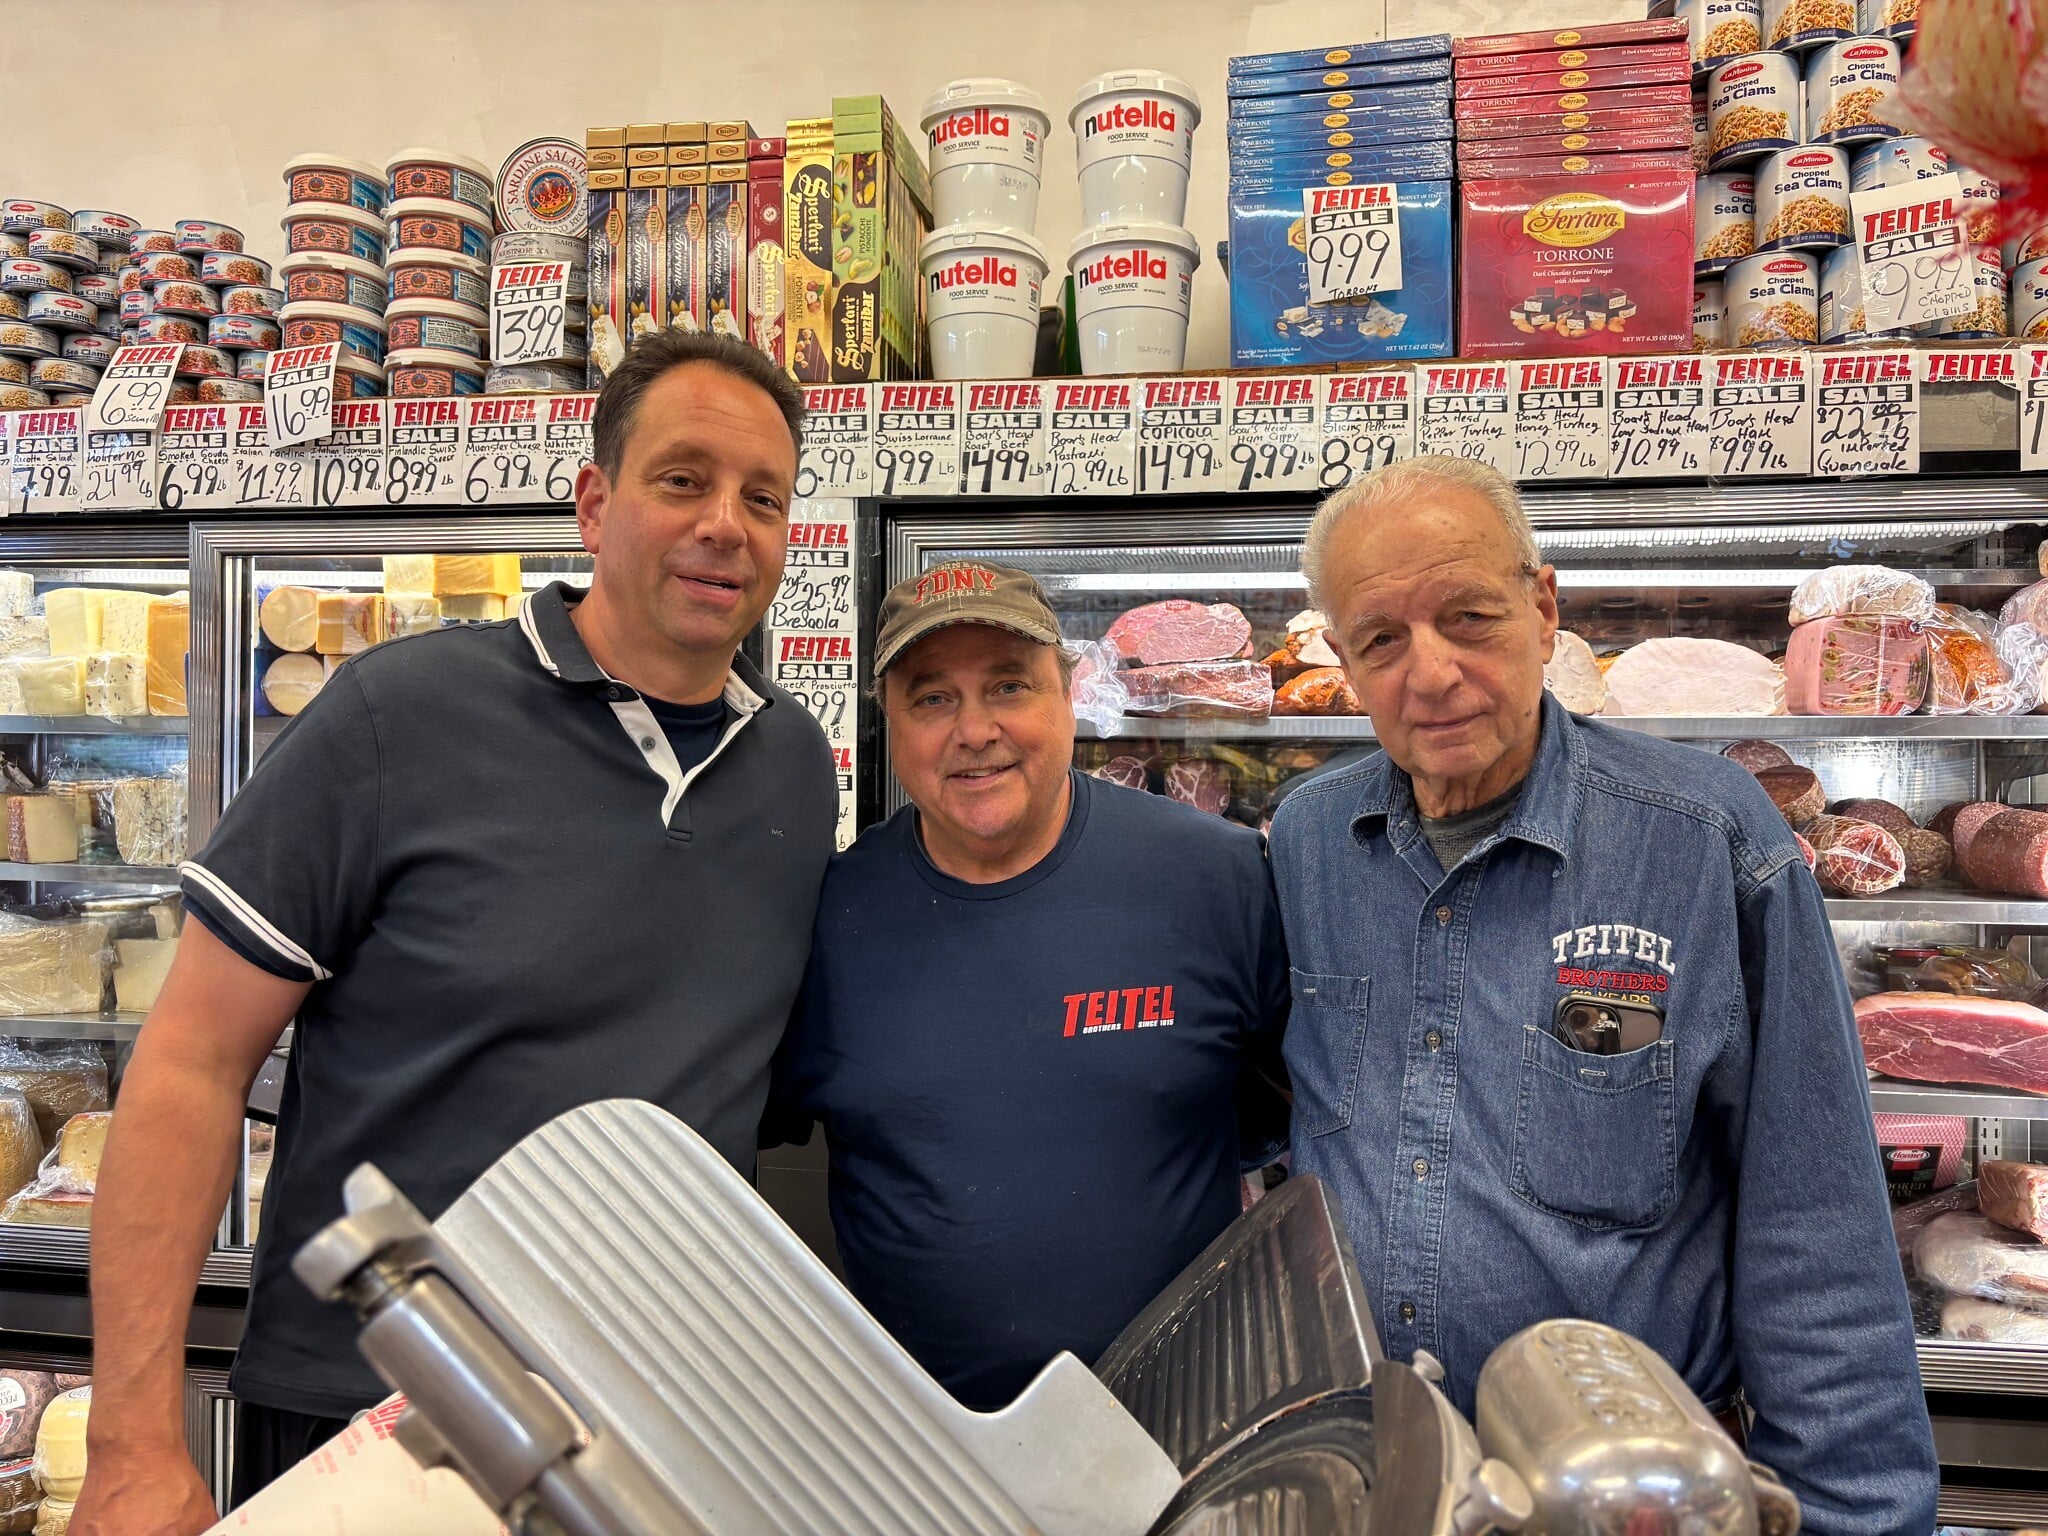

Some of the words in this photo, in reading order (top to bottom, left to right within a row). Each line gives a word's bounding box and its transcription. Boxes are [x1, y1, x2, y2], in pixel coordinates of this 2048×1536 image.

[1707, 4, 1731, 15] Sea
[1476, 56, 1518, 66] TORRONE
[1848, 63, 1885, 71] Chopped
[1476, 77, 1519, 87] TORRONE
[1723, 78, 1759, 93] Chopped
[1830, 74, 1851, 87] Sea
[1860, 70, 1897, 83] Clams
[1476, 98, 1518, 107] TORRONE
[1712, 97, 1729, 111] Sea
[1733, 86, 1776, 100] Clams
[1085, 100, 1176, 139] nutella
[930, 108, 1009, 151] nutella
[1107, 133, 1123, 141] FOOD
[944, 144, 956, 152] FOOD
[508, 151, 541, 205] SARDINE
[545, 149, 588, 177] SALATE
[1792, 169, 1830, 179] Chopped
[1775, 182, 1800, 195] Sea
[1803, 177, 1842, 190] Clams
[1962, 188, 1988, 199] Sea
[1312, 187, 1391, 215] TEITEL
[1714, 205, 1739, 214] Sea
[15, 215, 44, 224] Clams
[799, 173, 830, 255] Sperlari
[1315, 210, 1388, 232] SALE
[1527, 208, 1618, 233] Ferrara
[1863, 198, 1956, 243] TEITEL
[1876, 229, 1907, 240] BROTHERS
[1921, 223, 1938, 231] SINCE
[1869, 229, 1954, 261] SALE
[594, 236, 606, 290] Torrone
[635, 236, 647, 289] Torrone
[675, 233, 688, 287] Torrone
[715, 231, 728, 284] Torrone
[1533, 248, 1614, 262] TORRONE
[497, 264, 563, 290] TEITEL
[930, 257, 1017, 294] nutella
[1079, 250, 1167, 289] nutella
[1533, 269, 1547, 277] Dark
[1594, 268, 1613, 276] Nougat
[20, 274, 50, 284] Clams
[1767, 277, 1804, 285] Chopped
[498, 287, 558, 305] SALE
[1098, 284, 1113, 293] FOOD
[1750, 288, 1776, 299] Sea
[1779, 284, 1814, 297] Clams
[44, 308, 60, 316] Sea
[64, 310, 91, 322] Clams
[835, 296, 864, 372] Sperlari
[81, 349, 110, 359] Clams
[115, 346, 179, 365] TEITEL
[271, 345, 333, 373] TEITEL
[110, 366, 168, 377] SALE
[1521, 362, 1601, 391] TEITEL
[1617, 360, 1702, 389] TEITEL
[1717, 357, 1804, 386] TEITEL
[1822, 355, 1911, 385] TEITEL
[1928, 354, 2014, 383] TEITEL
[271, 367, 327, 389] SALE
[1427, 367, 1507, 395] TEITEL
[969, 385, 1042, 411] TEITEL
[1055, 385, 1130, 411] TEITEL
[1145, 381, 1221, 408] TEITEL
[1236, 379, 1313, 406] TEITEL
[1328, 376, 1408, 403] TEITEL
[1719, 386, 1799, 405] SALE
[1825, 387, 1906, 405] SALE
[881, 386, 954, 411] TEITEL
[1428, 397, 1503, 412] SALE
[1521, 392, 1598, 409] SALE
[1619, 391, 1698, 407] SALE
[164, 407, 227, 432] TEITEL
[394, 401, 458, 427] TEITEL
[470, 400, 536, 425] TEITEL
[971, 414, 1039, 428] SALE
[1056, 414, 1126, 428] SALE
[1147, 410, 1217, 425] SALE
[1237, 409, 1309, 423] SALE
[1330, 405, 1404, 420] SALE
[1453, 412, 1480, 423] Head
[1554, 408, 1578, 419] Head
[1660, 407, 1695, 423] Head
[1765, 406, 1800, 425] Head
[18, 412, 77, 437] TEITEL
[883, 414, 951, 429] SALE
[1264, 423, 1287, 432] Head
[1515, 423, 1550, 435] Honey
[1555, 413, 1600, 429] Turkey
[165, 433, 223, 448] SALE
[395, 428, 455, 443] SALE
[471, 426, 533, 441] SALE
[875, 429, 912, 445] Swiss
[914, 432, 952, 441] Lorraine
[1008, 429, 1034, 439] Head
[1091, 431, 1121, 445] Head
[1237, 434, 1263, 444] Ham
[1611, 425, 1635, 439] Low
[20, 438, 75, 453] SALE
[232, 448, 264, 456] Italian
[430, 443, 457, 454] Swiss
[510, 440, 541, 451] Cheese
[965, 441, 993, 450] Roast
[1001, 441, 1029, 449] Beef
[159, 449, 194, 461] Smoked
[201, 449, 229, 458] Gouda
[785, 551, 844, 566] SALE
[912, 568, 997, 604] FDNY
[919, 589, 975, 608] LADDER
[781, 637, 852, 662] TEITEL
[782, 665, 848, 679] SALE
[812, 680, 857, 690] Prosciutto
[1553, 925, 1676, 976] TEITEL
[1557, 966, 1669, 992] BROTHERS
[1063, 985, 1176, 1037] TEITEL
[1082, 1023, 1122, 1034] BROTHERS
[1138, 1020, 1158, 1028] SINCE
